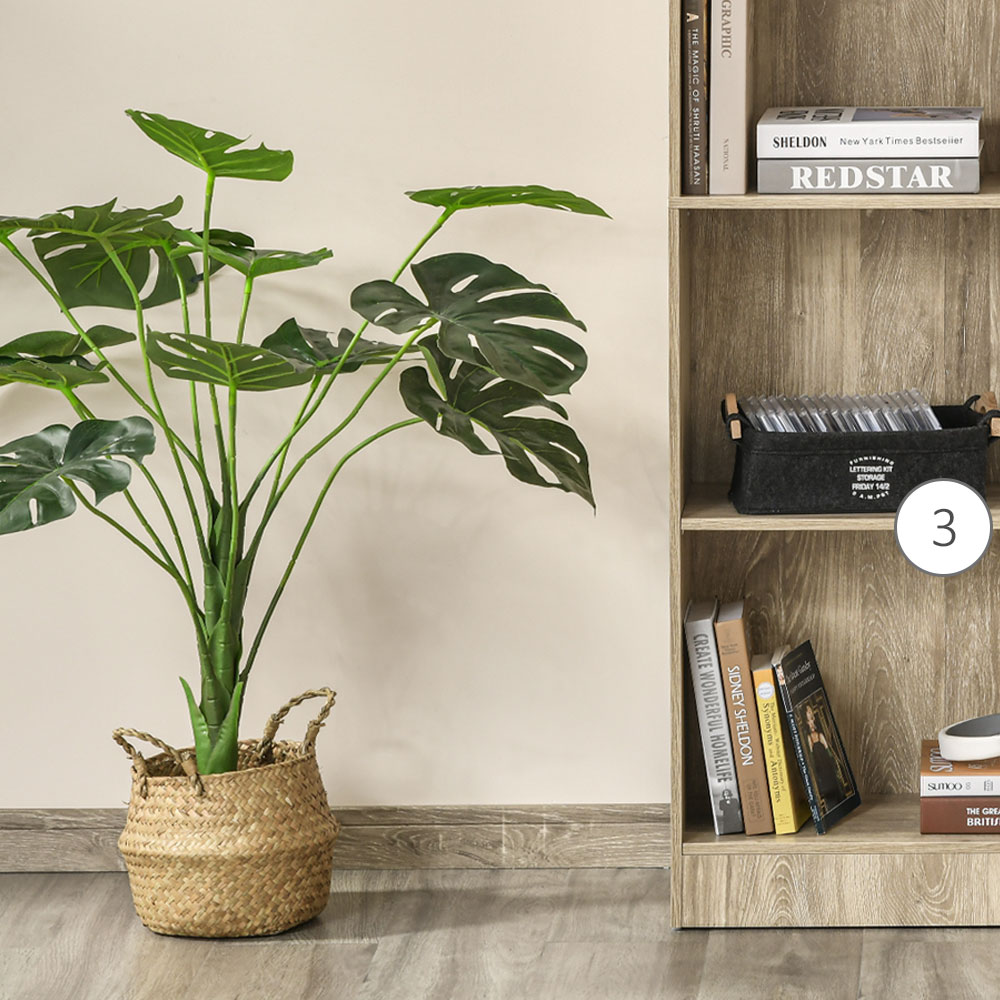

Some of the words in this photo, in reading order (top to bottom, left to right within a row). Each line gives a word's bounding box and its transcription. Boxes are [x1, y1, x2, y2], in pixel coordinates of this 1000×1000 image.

[692, 49, 700, 85] MAGIC
[692, 89, 700, 103] OF
[692, 107, 700, 142] SHRUTI
[772, 136, 827, 148] SHELDON
[839, 137, 860, 145] New
[885, 136, 914, 145] Times
[692, 145, 701, 185] HAASAN
[790, 165, 954, 189] REDSTAR
[851, 483, 875, 491] FRIDAY
[857, 474, 885, 482] STORAGE
[693, 633, 712, 671] CREATE
[700, 670, 723, 732] WONDERFUL
[727, 665, 745, 706] SIDNEY
[734, 707, 754, 767] SHELDON
[761, 703, 774, 746] Synonyms
[769, 760, 783, 803] Antonyms
[710, 733, 733, 785] HOMELIFE
[966, 807, 980, 815] THE
